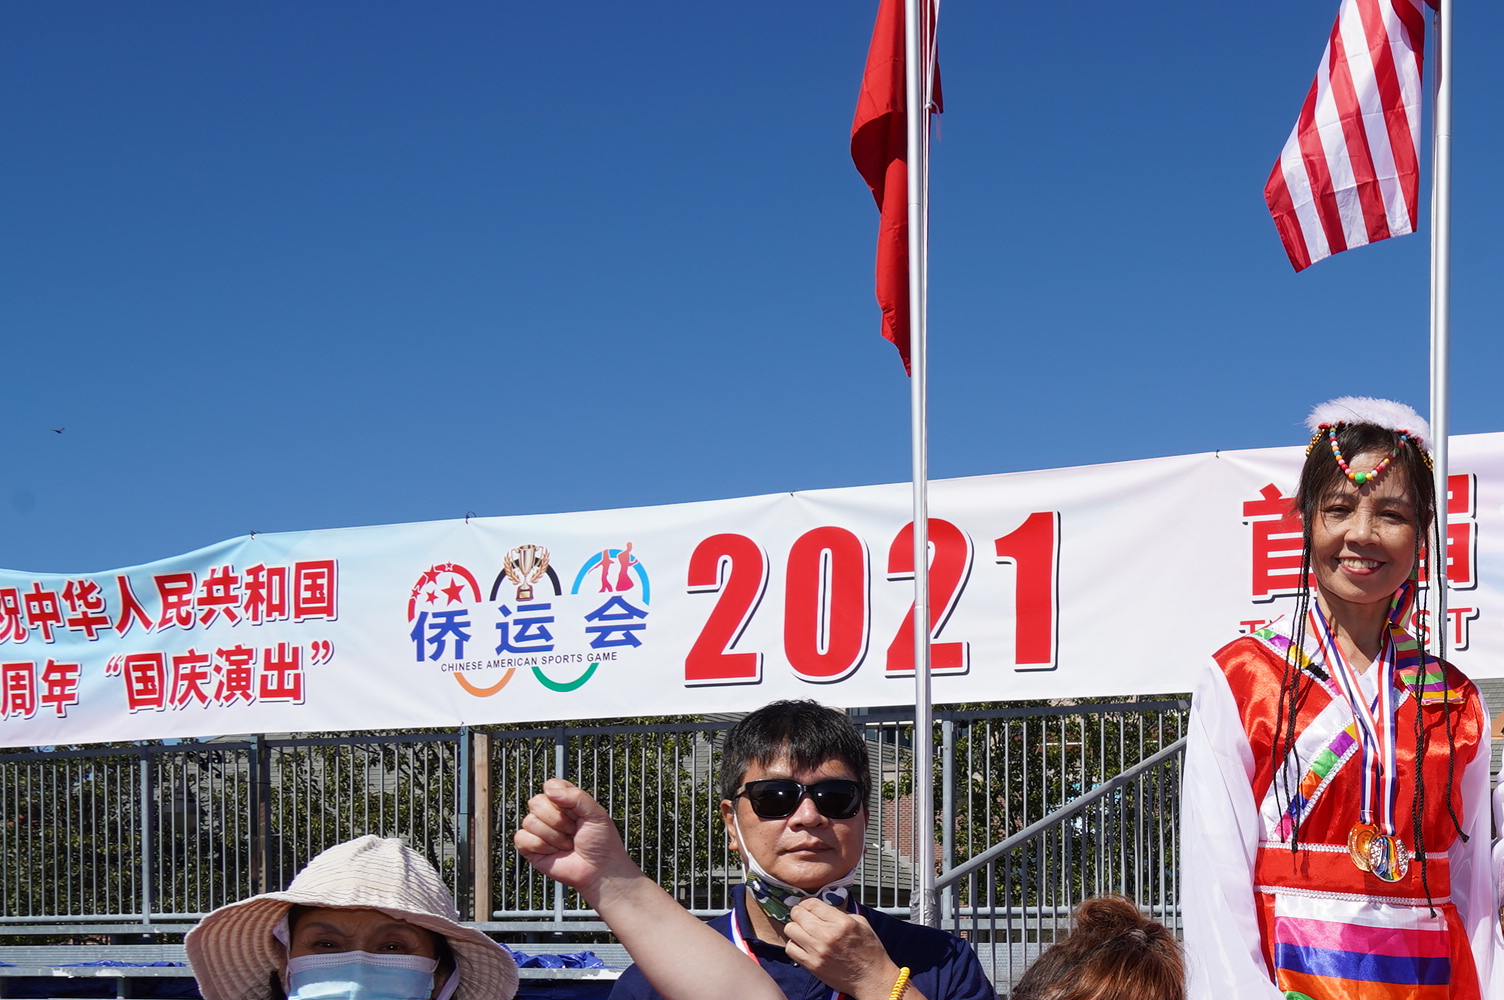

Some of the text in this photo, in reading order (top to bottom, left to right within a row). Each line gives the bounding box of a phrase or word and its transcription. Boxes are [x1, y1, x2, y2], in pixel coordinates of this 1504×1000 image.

[410, 595, 650, 663] 侨运会
[685, 511, 1056, 682] 2021
[440, 651, 618, 673] CHINESE AMERICAN SPORTS GAME
